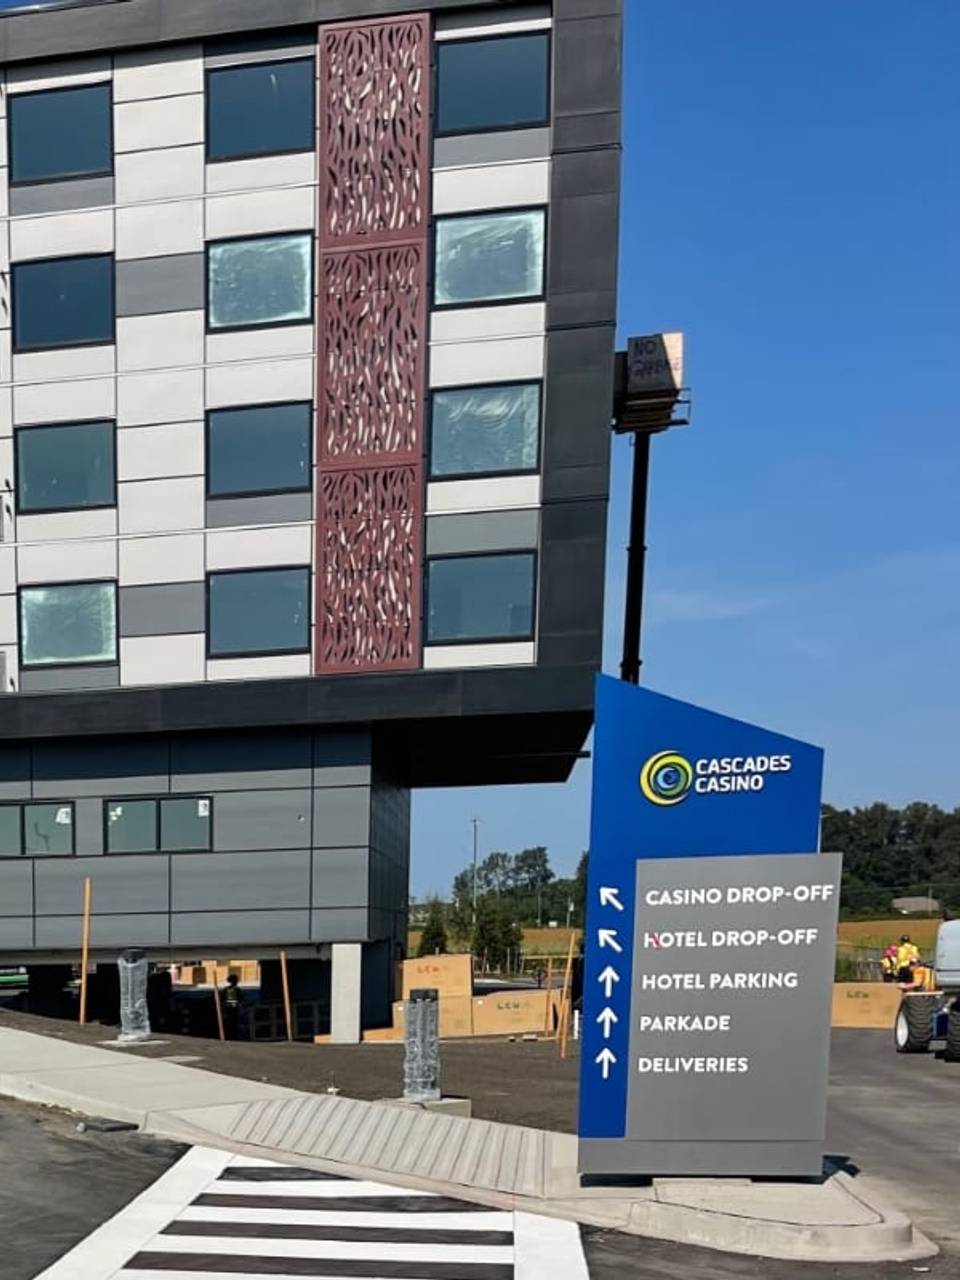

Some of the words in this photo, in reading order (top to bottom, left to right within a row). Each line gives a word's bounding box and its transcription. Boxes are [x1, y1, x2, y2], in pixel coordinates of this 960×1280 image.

[695, 755, 791, 775] CASCADES
[694, 774, 764, 793] CASINO
[645, 888, 722, 906] CASINO
[726, 884, 835, 904] DROP-OFF
[643, 932, 707, 948] HOTEL
[711, 928, 818, 947] DROP-OFF
[642, 973, 705, 990] HOTEL
[709, 972, 799, 989] PARKING
[639, 1015, 731, 1031] PARKADE
[638, 1057, 749, 1073] DELIVERIES
